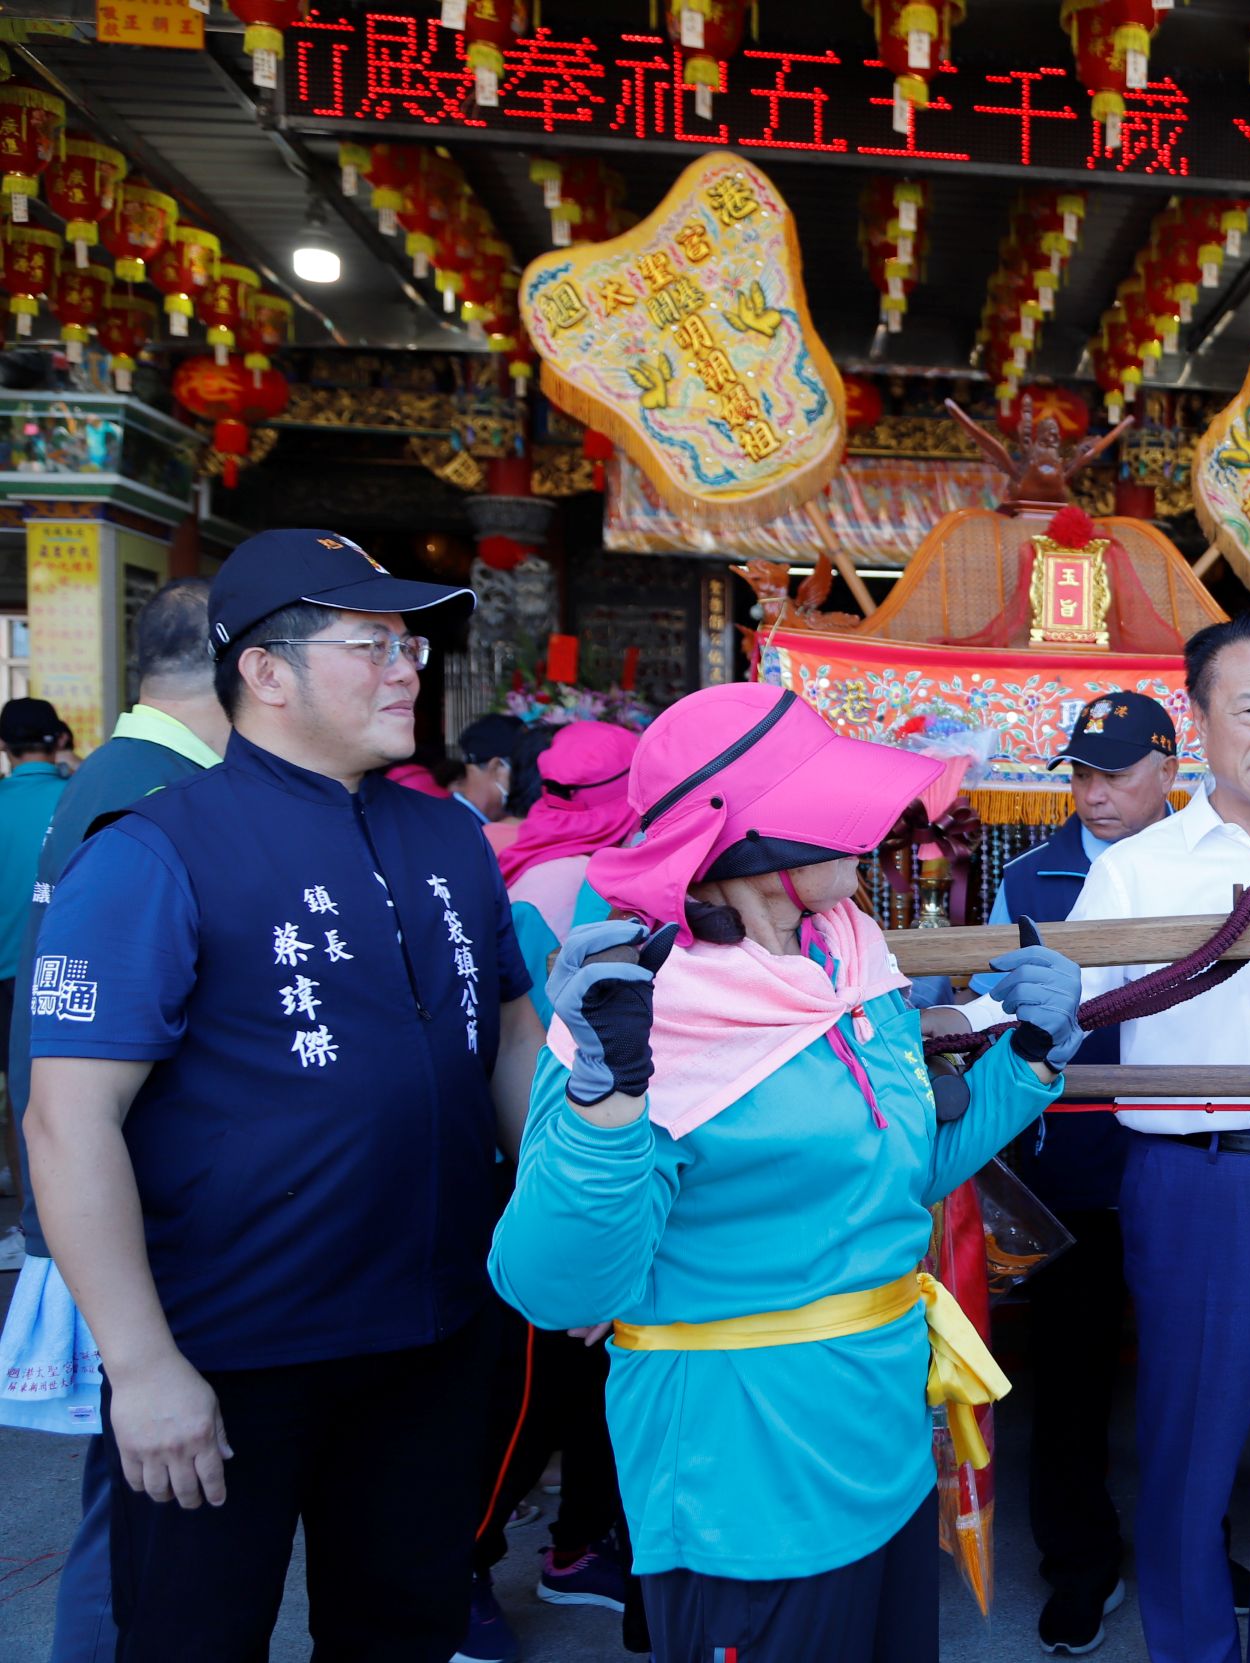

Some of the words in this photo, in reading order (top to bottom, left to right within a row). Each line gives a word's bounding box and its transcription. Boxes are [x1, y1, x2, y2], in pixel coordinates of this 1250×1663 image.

[1057, 568, 1080, 619] 玉旨
[828, 679, 874, 725] 港
[303, 884, 354, 963] 鎮長
[272, 921, 340, 1068] 蔡瑋傑
